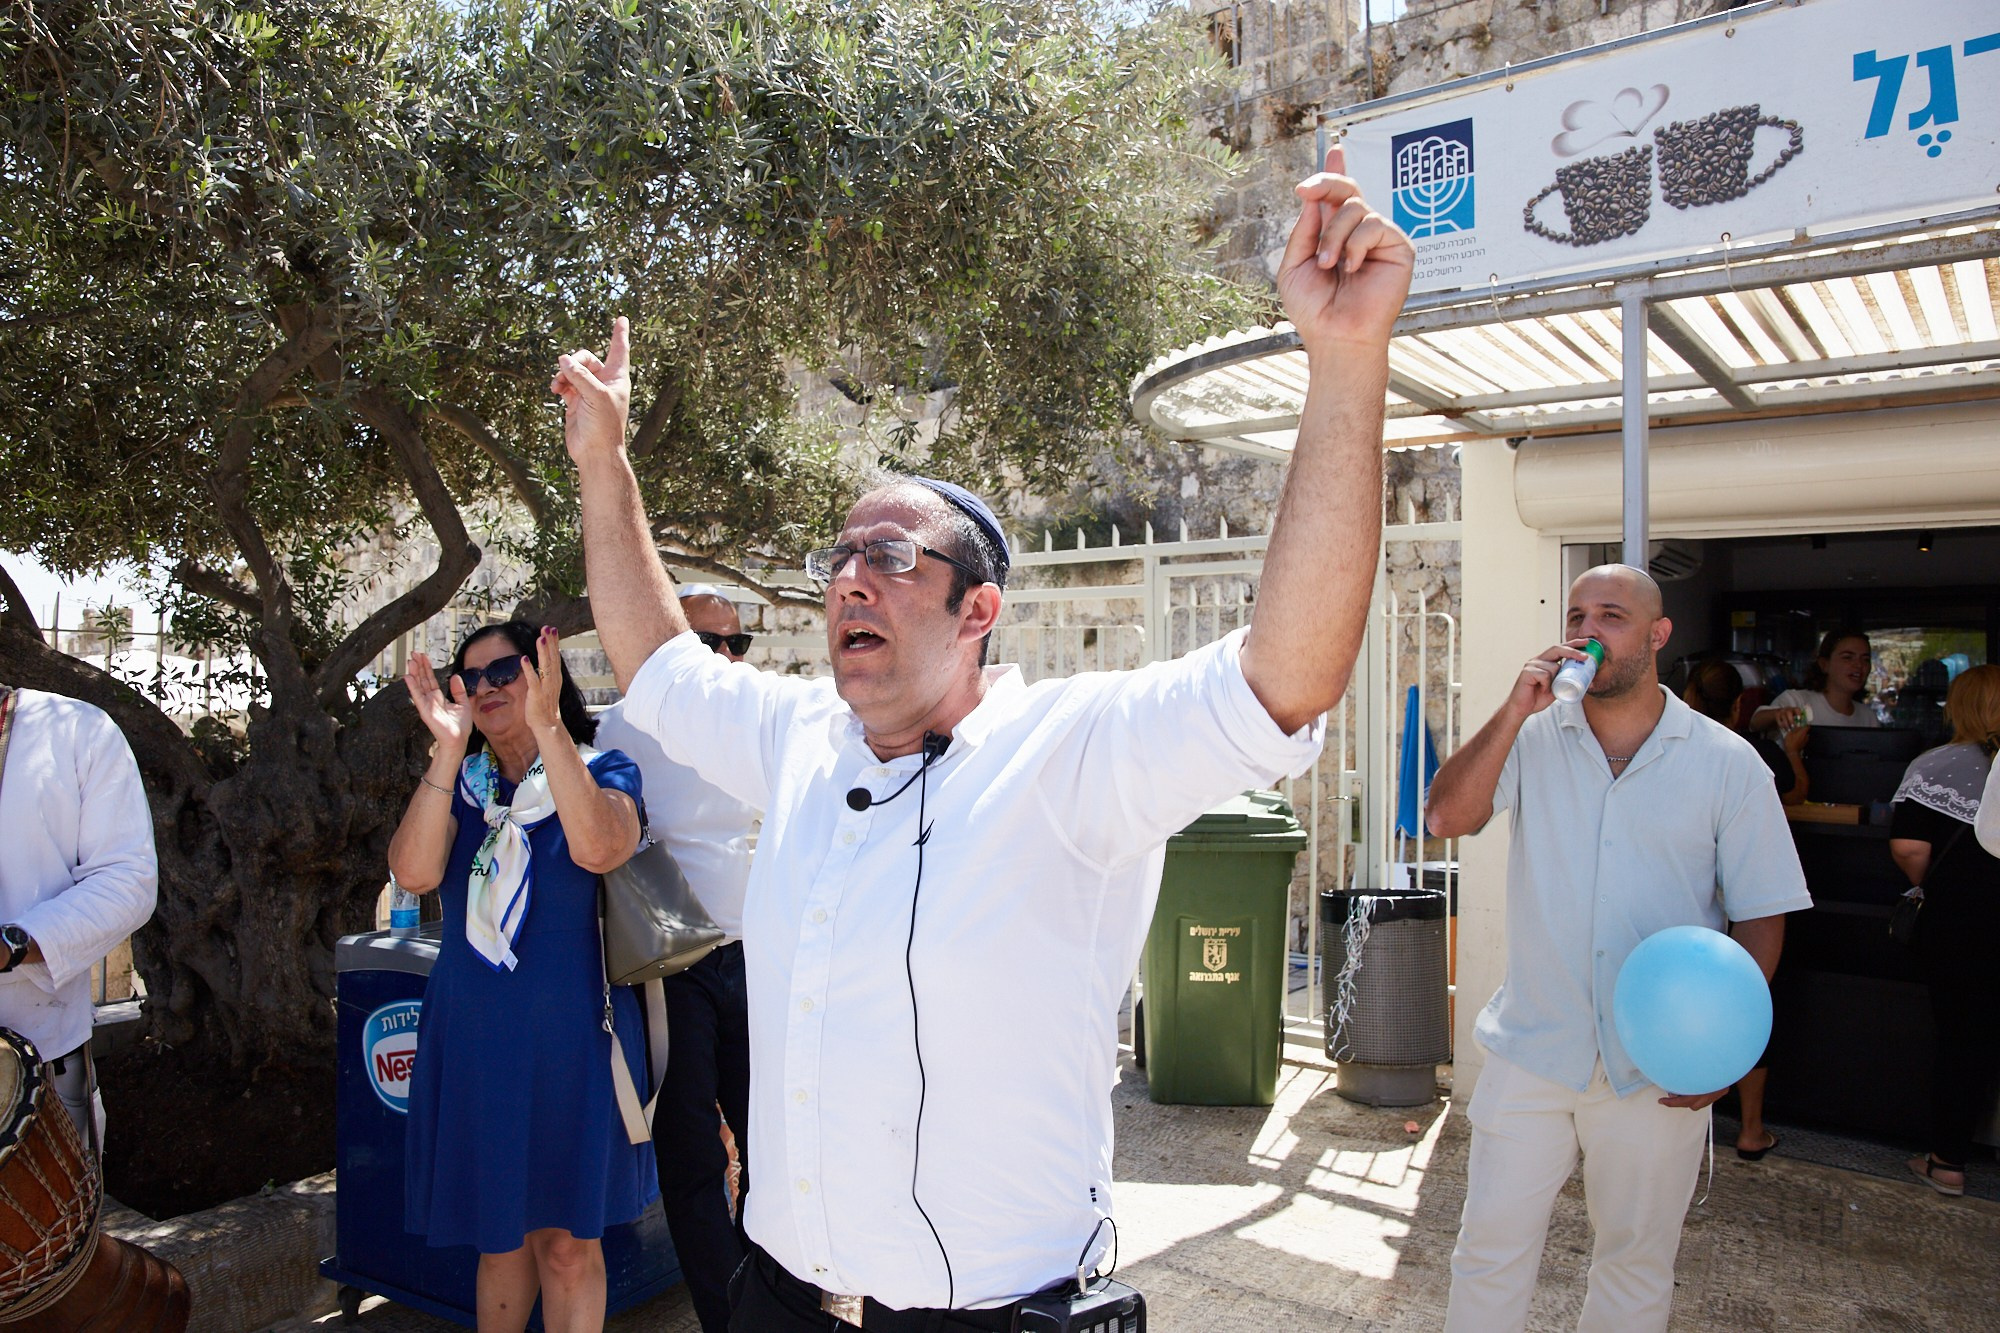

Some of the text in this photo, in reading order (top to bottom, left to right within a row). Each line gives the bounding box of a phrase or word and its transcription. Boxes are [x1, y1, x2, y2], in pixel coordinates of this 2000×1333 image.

[1417, 236, 1476, 253] החברה לשיקום
[1416, 248, 1486, 266] הרובע היהודי בעיר
[1412, 265, 1462, 280] בירושלים בע
[1189, 924, 1241, 937] עיריית ירושלים
[1189, 971, 1240, 984] אגף התברואה
[381, 1006, 420, 1032] לידות
[376, 1049, 416, 1082] Nes
